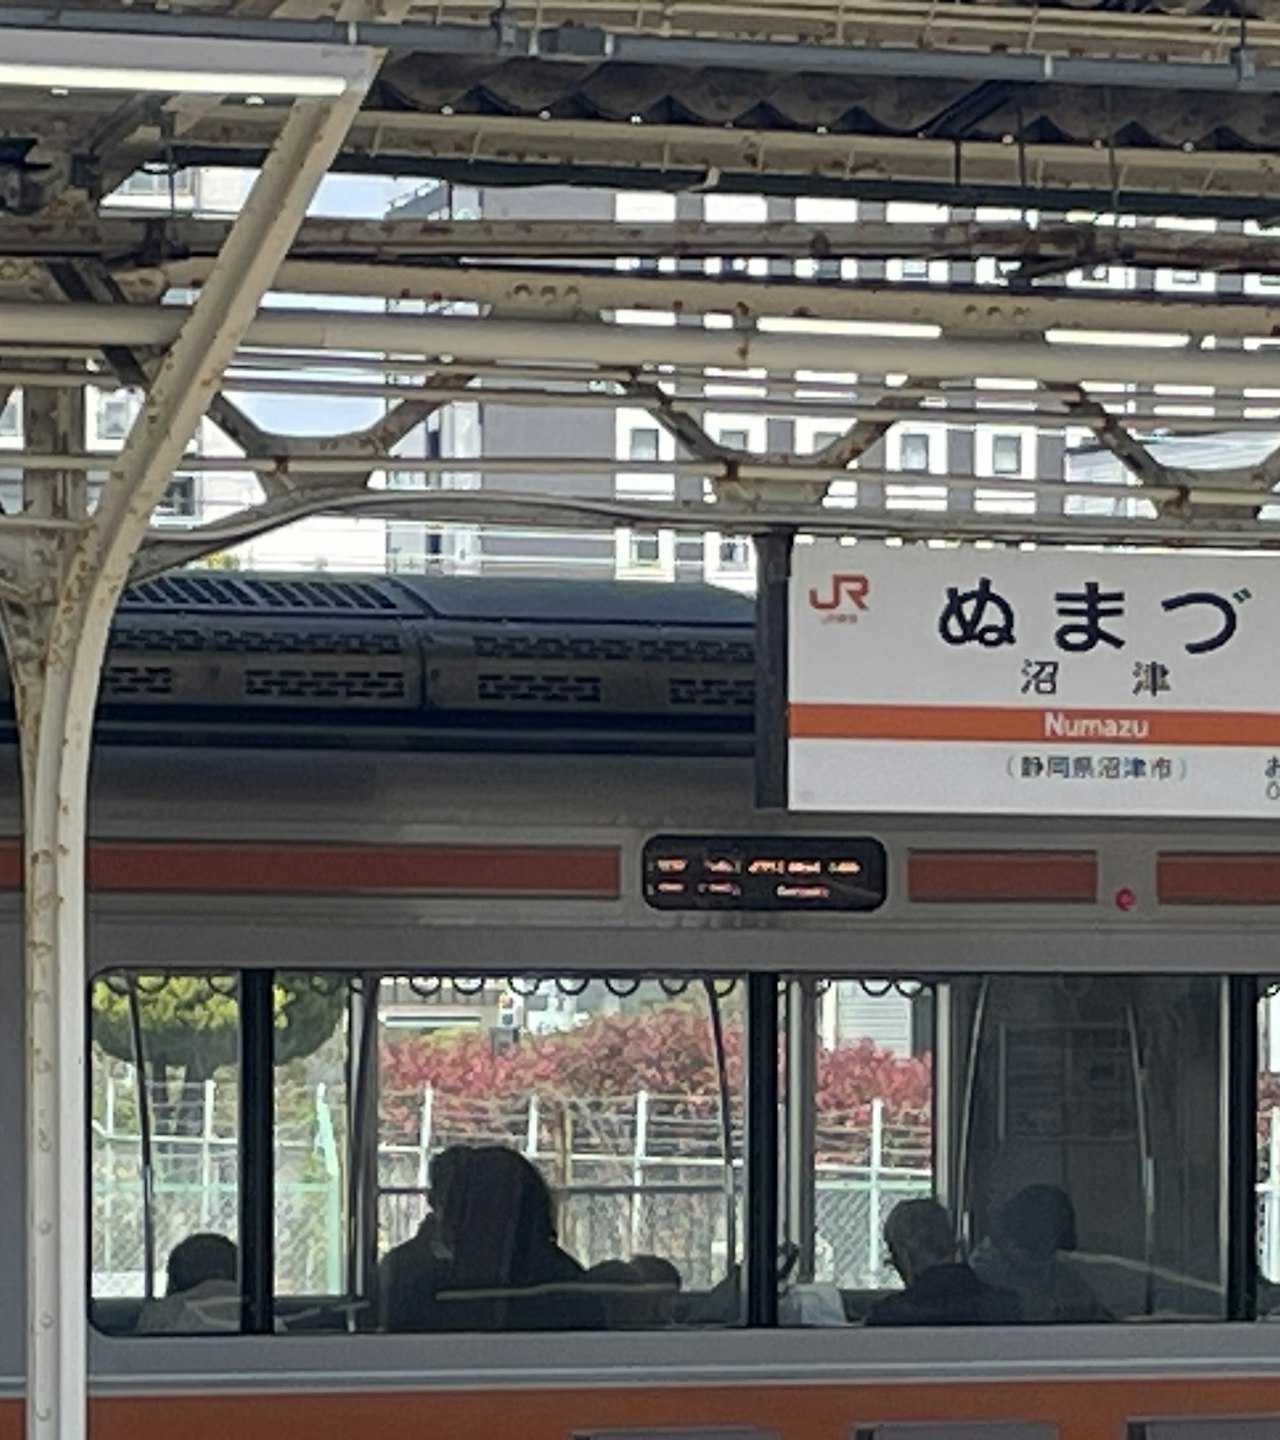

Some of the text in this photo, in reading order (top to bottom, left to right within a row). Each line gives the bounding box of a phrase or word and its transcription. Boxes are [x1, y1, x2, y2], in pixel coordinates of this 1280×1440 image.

[809, 574, 869, 610] JR
[939, 577, 1252, 654] ぬまづ
[1021, 659, 1171, 697] 沼津
[1044, 711, 1149, 738] Numazu
